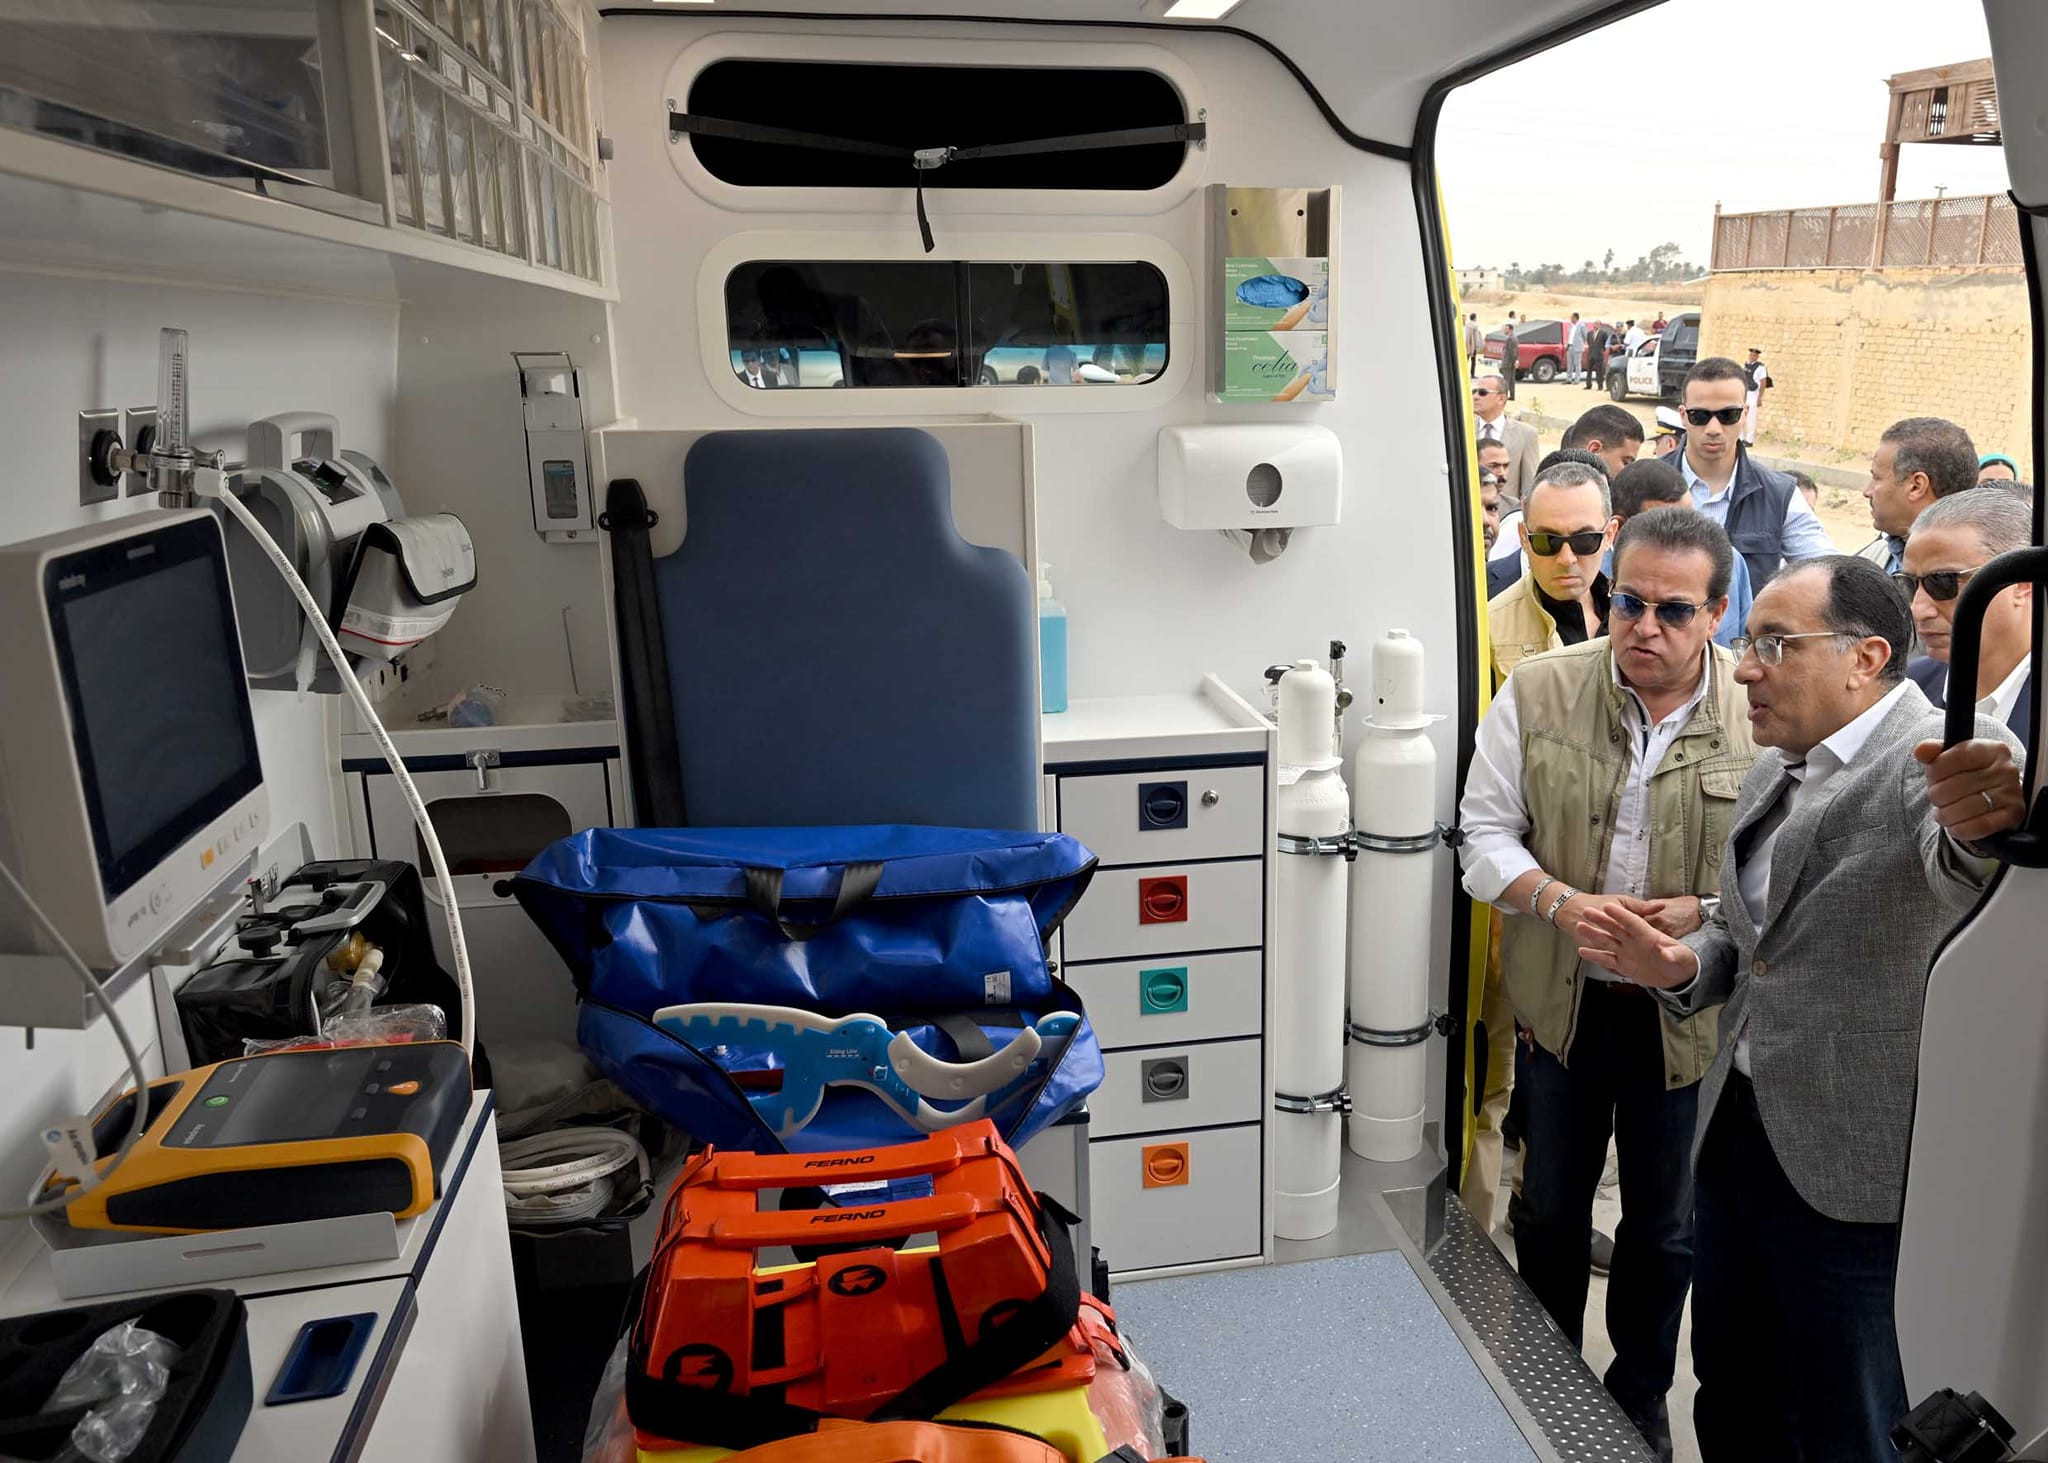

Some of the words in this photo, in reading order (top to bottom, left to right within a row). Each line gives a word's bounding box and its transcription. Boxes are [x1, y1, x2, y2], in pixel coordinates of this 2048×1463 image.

[1630, 376, 1653, 385] POLICE
[803, 1156, 874, 1168] FERNO
[809, 1210, 885, 1224] FERNO
